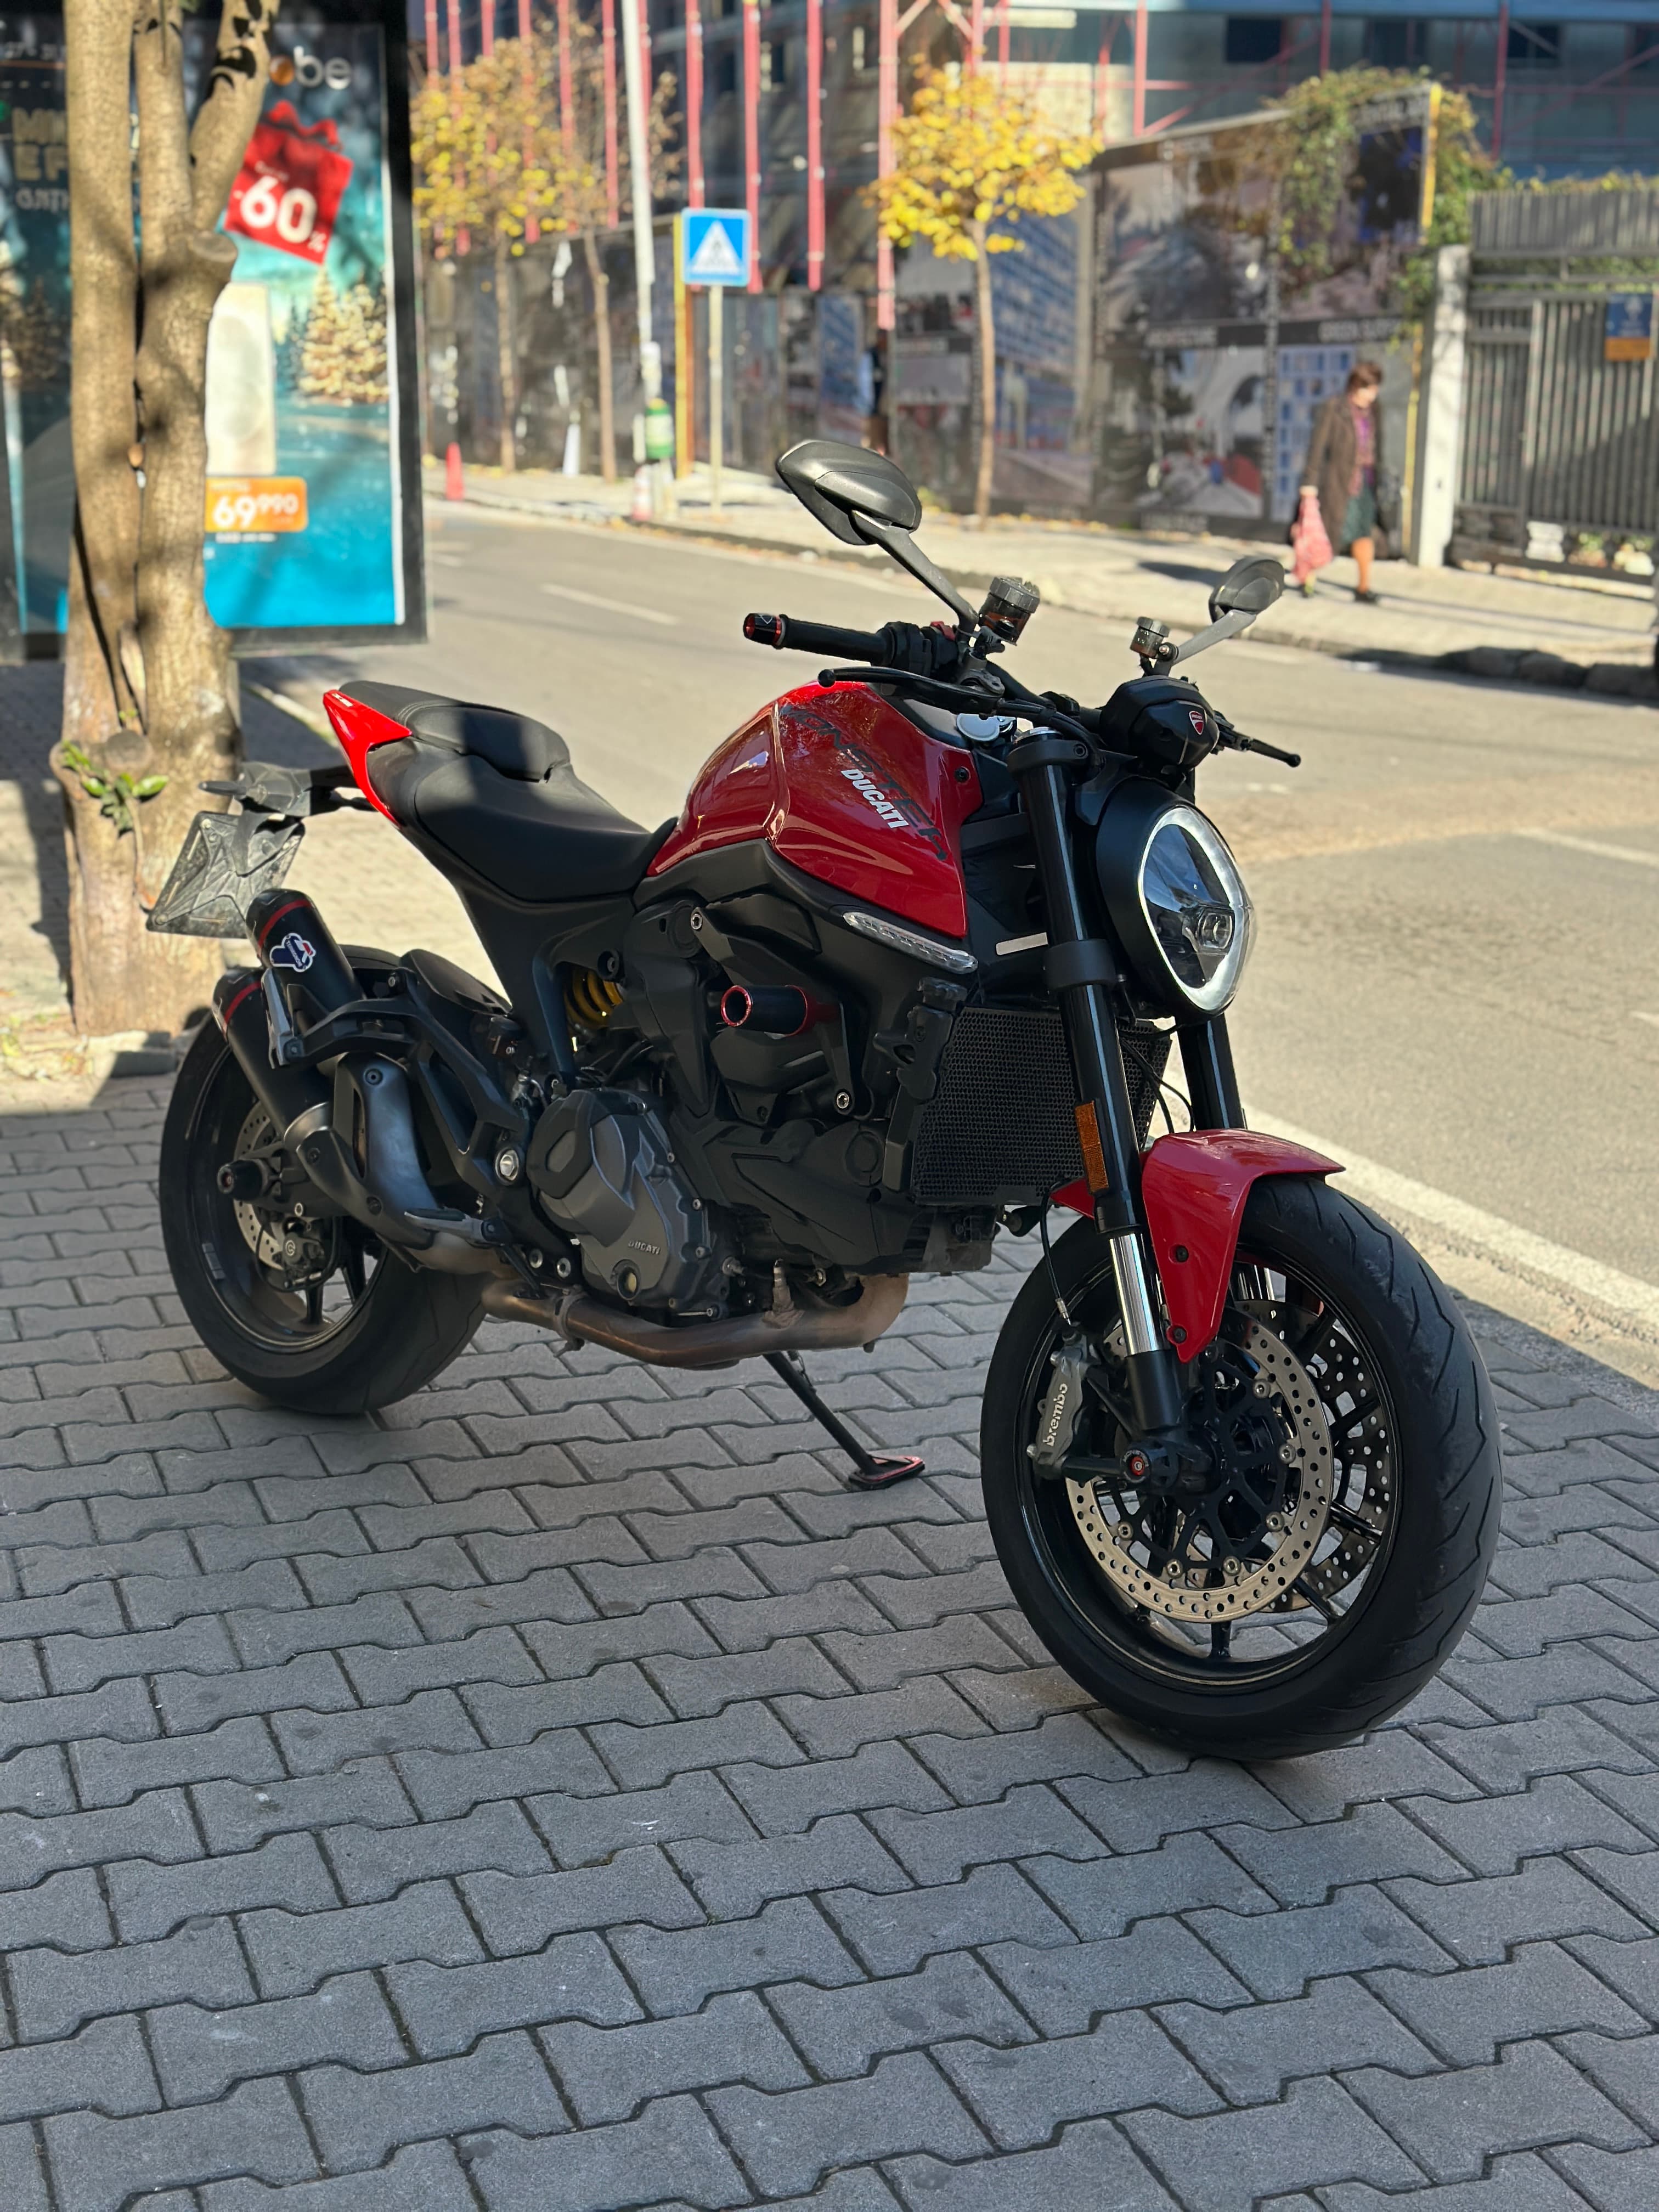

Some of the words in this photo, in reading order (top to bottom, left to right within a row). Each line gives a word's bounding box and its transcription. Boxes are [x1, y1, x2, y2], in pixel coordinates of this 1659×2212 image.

[840, 769, 909, 828] DUCATI
[628, 1240, 661, 1255] DUCATI
[1042, 1383, 1068, 1447] brembo
